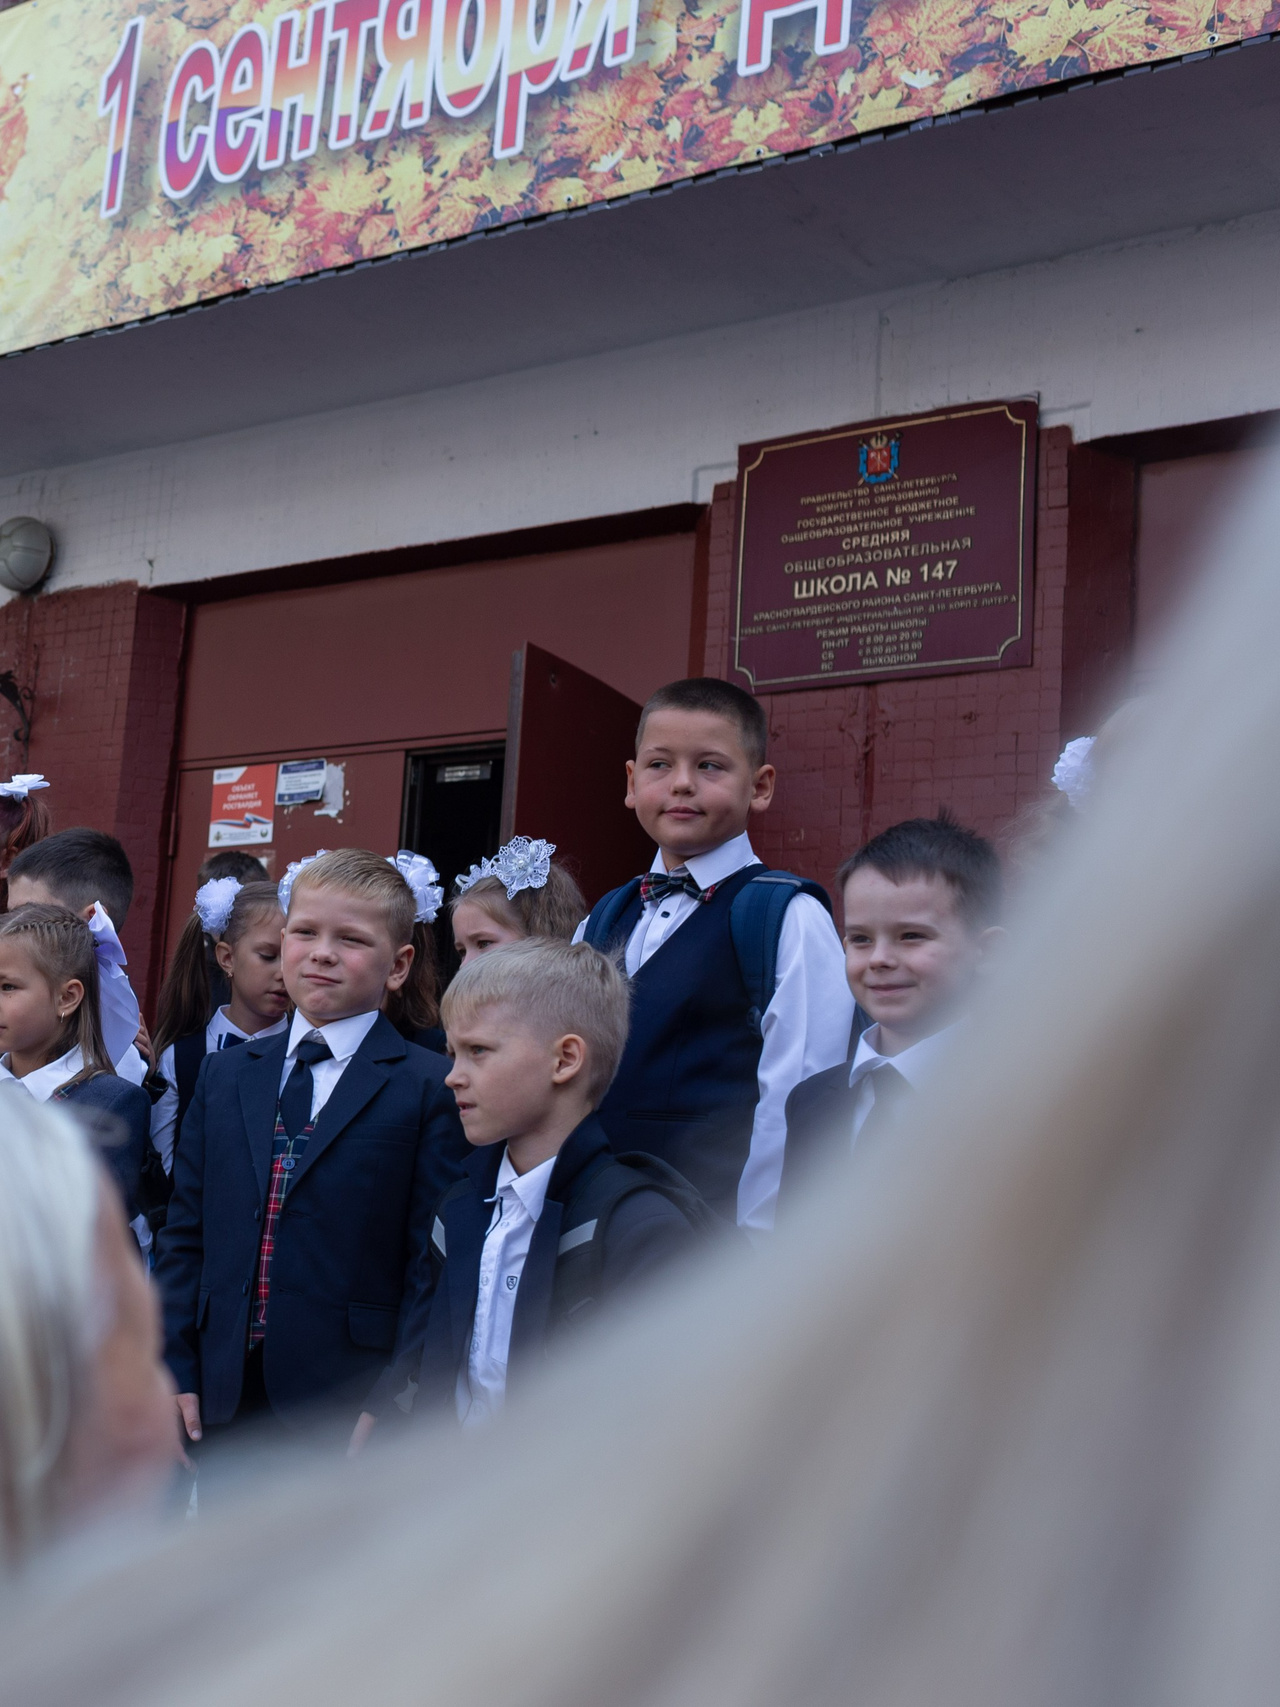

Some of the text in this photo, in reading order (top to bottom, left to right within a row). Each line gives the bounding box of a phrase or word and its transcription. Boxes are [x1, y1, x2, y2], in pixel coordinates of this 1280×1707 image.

[98, 15, 145, 219] 1
[800, 473, 958, 506] ПРАВИТЕЛЬСТВО САНКТ-ПЕТЕРБУРГА
[816, 487, 940, 514] КОМИТЕТ ПО ОБРАЗОВАНИЮ
[781, 506, 977, 545] ОБЩЕОБРАЗОВАТЕЛЬНОЕ УЧРЕЖДЕНИЕ
[797, 496, 960, 529] ГОСУДАРСТВЕННОЕ БЮДЖЕТНОЕ
[784, 537, 972, 574] ОБЩЕОБРАЗОВАТЕЛЬНАЯ
[842, 529, 910, 551] СРЕДНЯЯ
[794, 560, 958, 600] ШКОЛА № 147
[753, 582, 1002, 622] КРАСНОГВАРДЕЙСКОГО РАЙОНА САНКТ-ПЕТЕРБУРГА
[816, 626, 849, 639] РЕЖИМ
[850, 623, 889, 635] РАБОТЫ
[821, 651, 835, 661] СБ
[862, 653, 917, 667] ВЫХОДНОЙ
